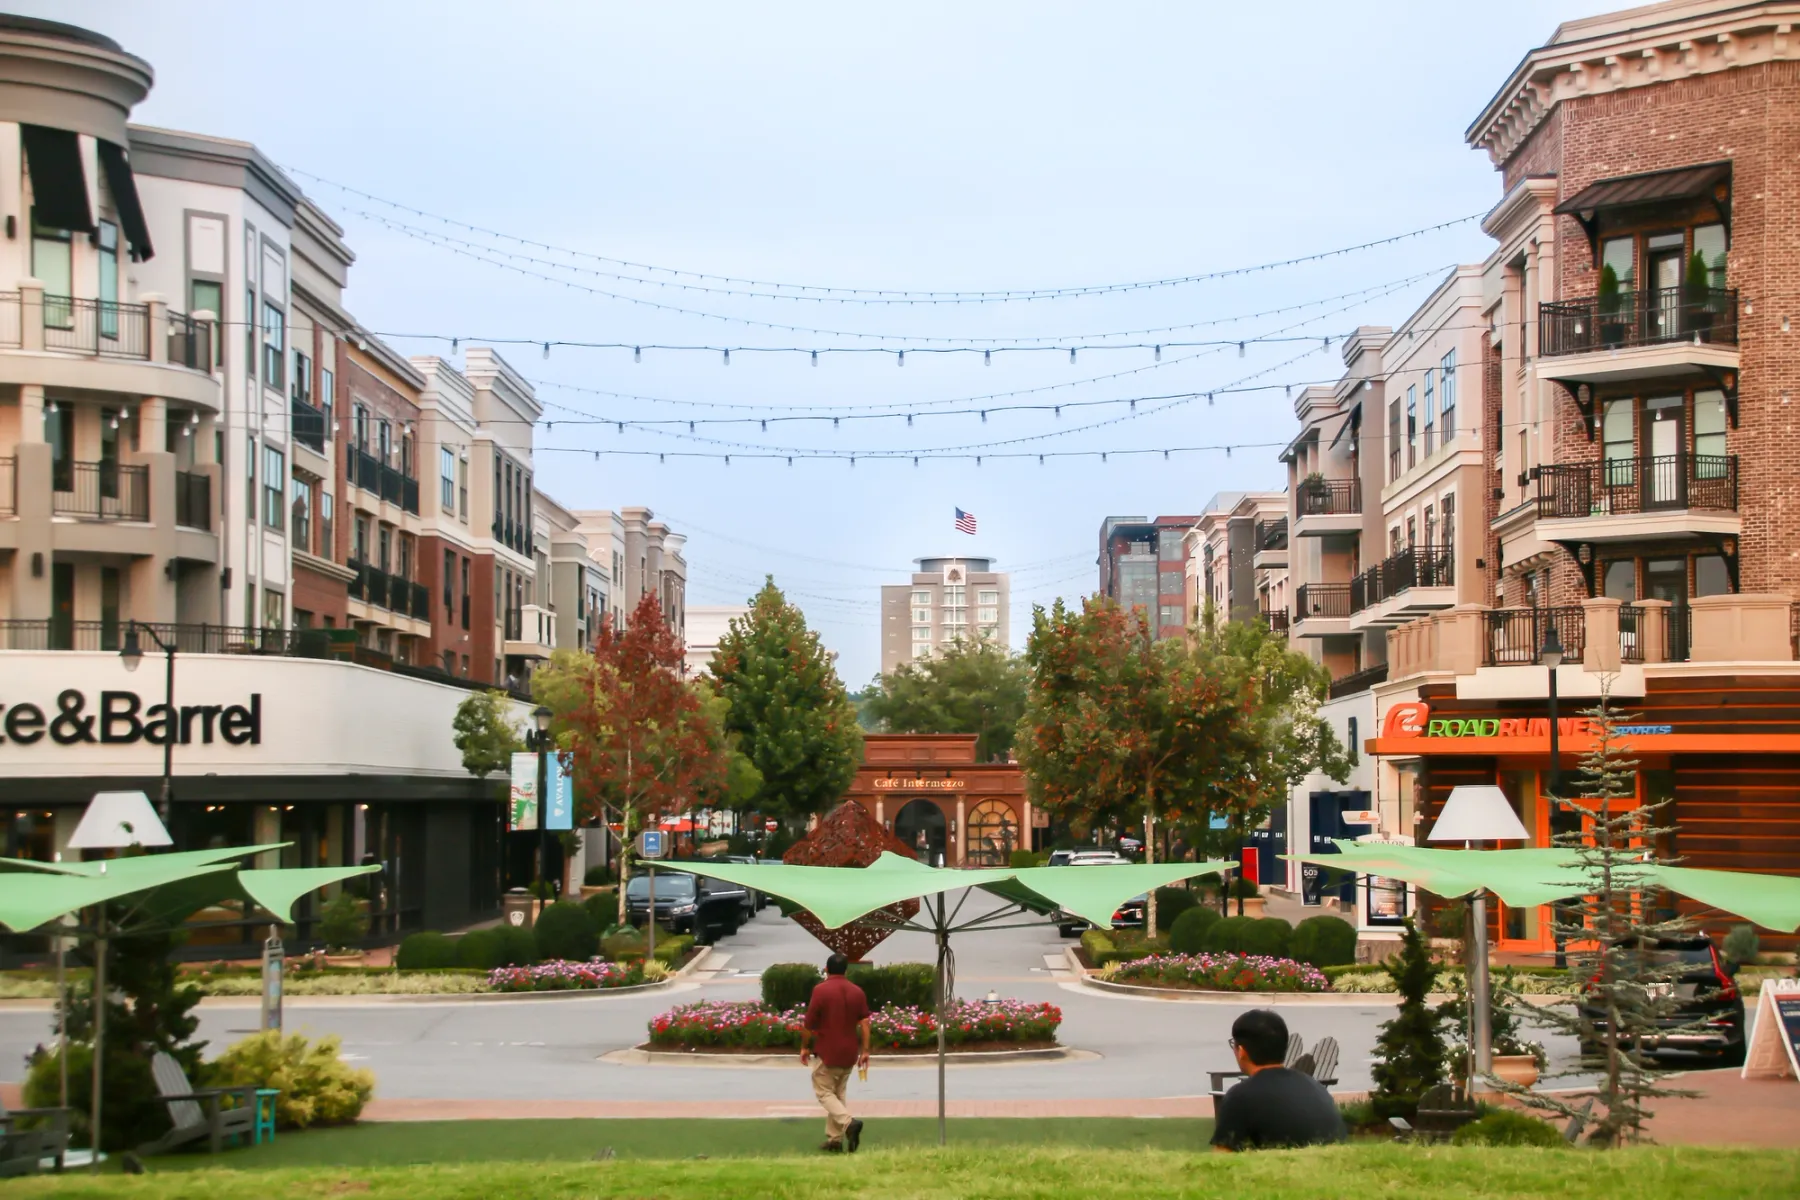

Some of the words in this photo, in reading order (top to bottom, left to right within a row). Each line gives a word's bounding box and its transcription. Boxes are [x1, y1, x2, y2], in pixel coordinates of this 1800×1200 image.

[0, 689, 261, 746] e&Barrel
[556, 766, 564, 806] AVALON
[874, 778, 899, 788] Café
[903, 778, 964, 788] Intermezzo
